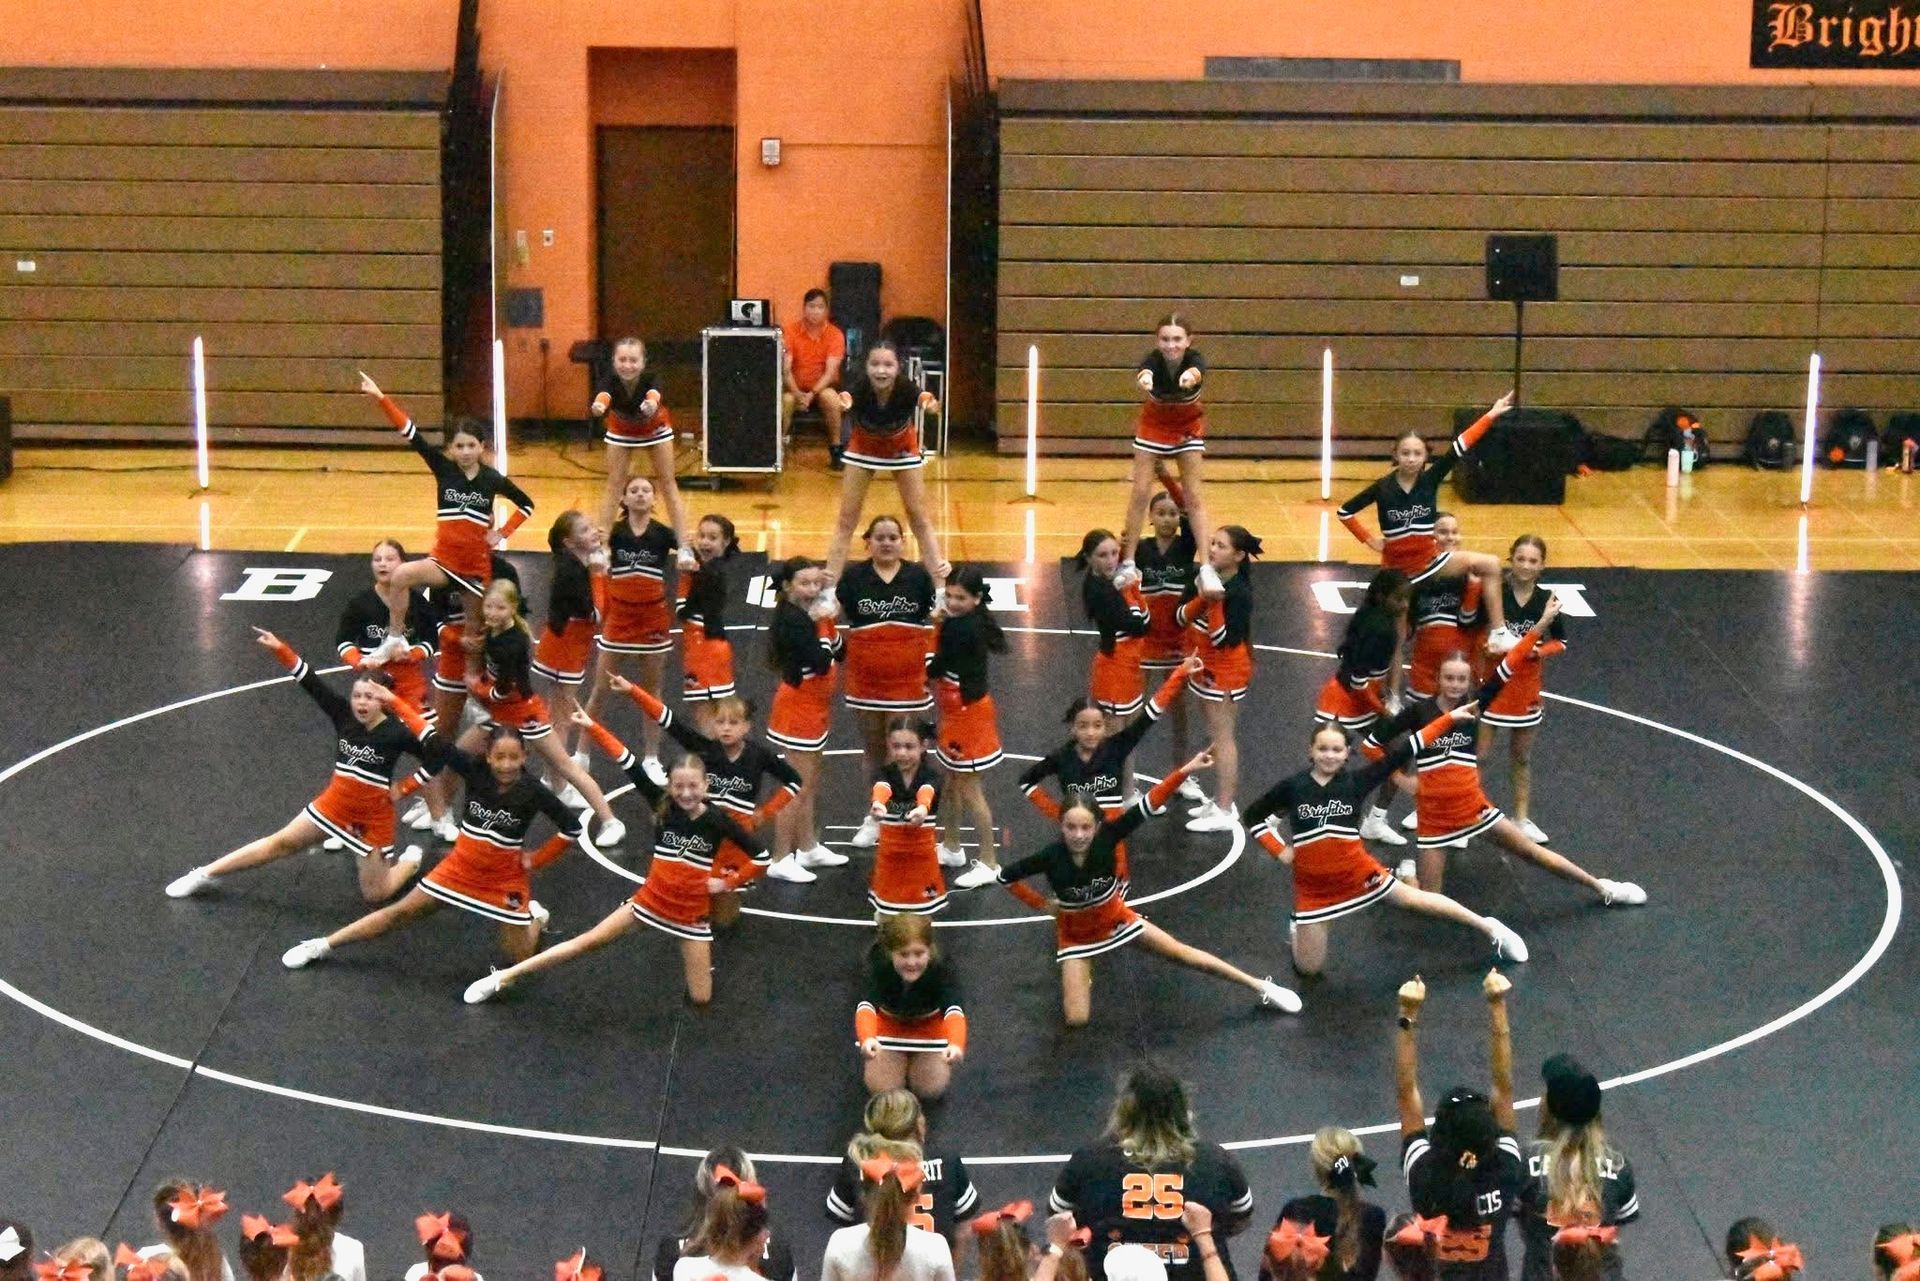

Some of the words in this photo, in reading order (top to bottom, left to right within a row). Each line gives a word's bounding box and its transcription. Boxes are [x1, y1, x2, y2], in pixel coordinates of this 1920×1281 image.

[445, 488, 490, 511] Brighton
[857, 596, 920, 618] Brighton
[339, 738, 385, 767] Brighton
[470, 801, 521, 831] Brighton
[1297, 799, 1353, 828] Brighton
[662, 831, 714, 858] Brighton
[1122, 1173, 1184, 1220] 25
